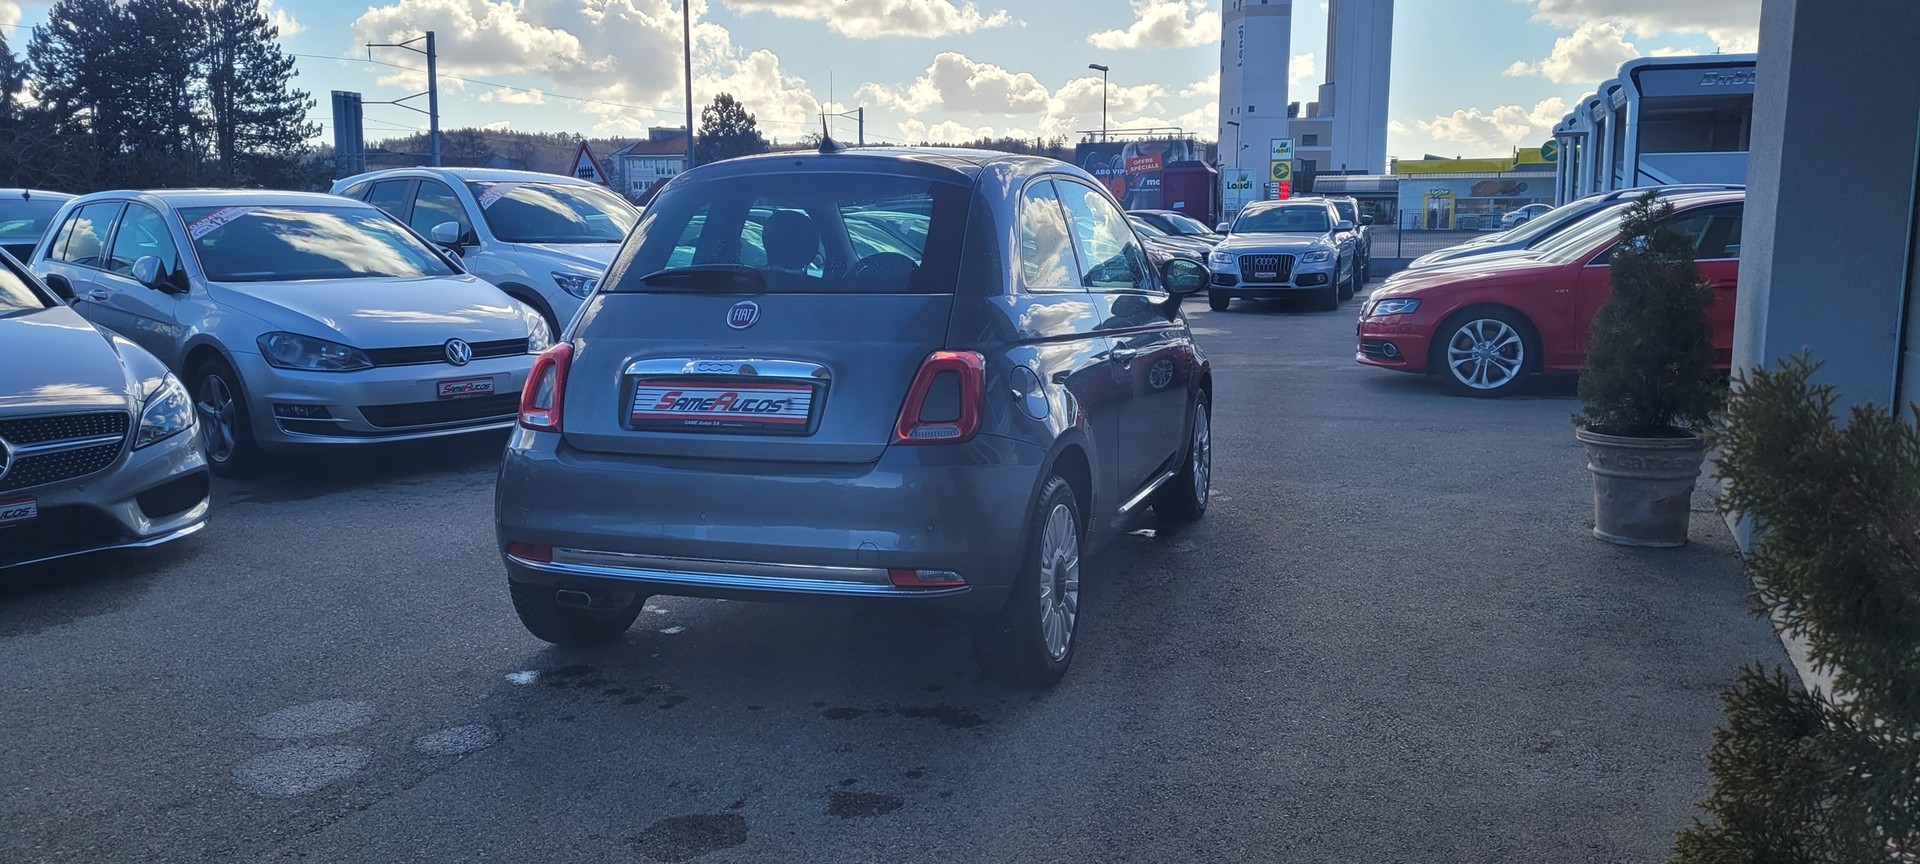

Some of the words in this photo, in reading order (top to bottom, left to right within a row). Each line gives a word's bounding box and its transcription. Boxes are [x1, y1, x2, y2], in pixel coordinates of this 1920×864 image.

[1133, 157, 1154, 165] OFFRE
[1130, 163, 1159, 172] SPÉCIALE
[1227, 180, 1253, 190] Landi
[733, 308, 754, 321] FIAT
[698, 361, 734, 372] 500
